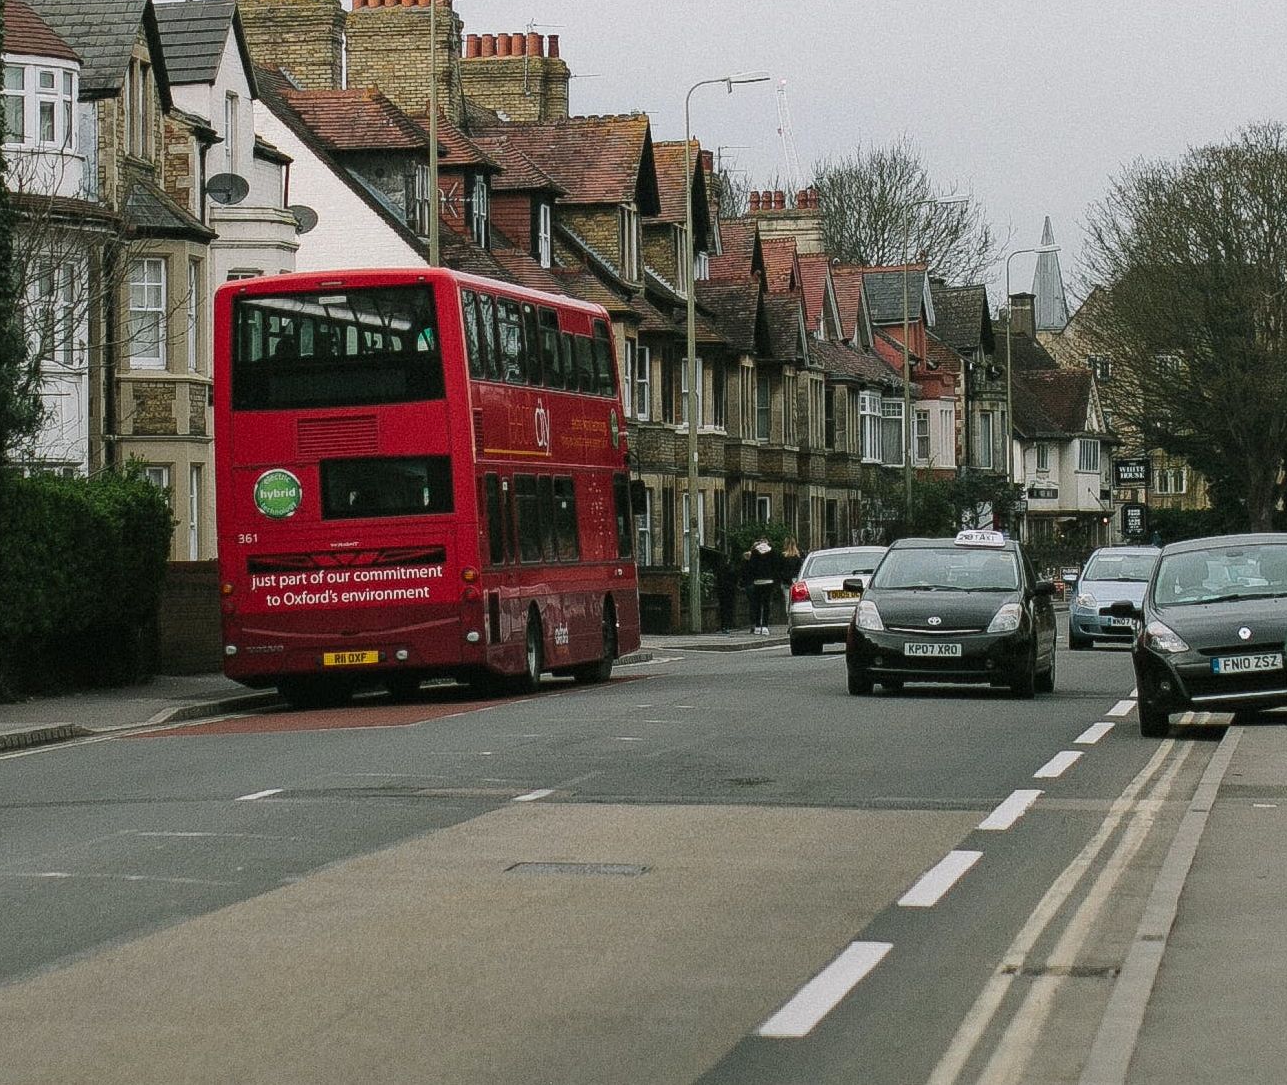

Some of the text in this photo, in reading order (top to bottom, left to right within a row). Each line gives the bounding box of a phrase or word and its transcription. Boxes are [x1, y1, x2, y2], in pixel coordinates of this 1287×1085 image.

[260, 487, 296, 500] hybrid
[237, 533, 258, 544] 361
[251, 565, 443, 591] just part of our commitment
[266, 586, 430, 607] to Oxford's environment
[908, 644, 958, 655] KP07 XRO
[348, 652, 368, 664] OXF
[1223, 655, 1278, 671] FN10 ZSZ
